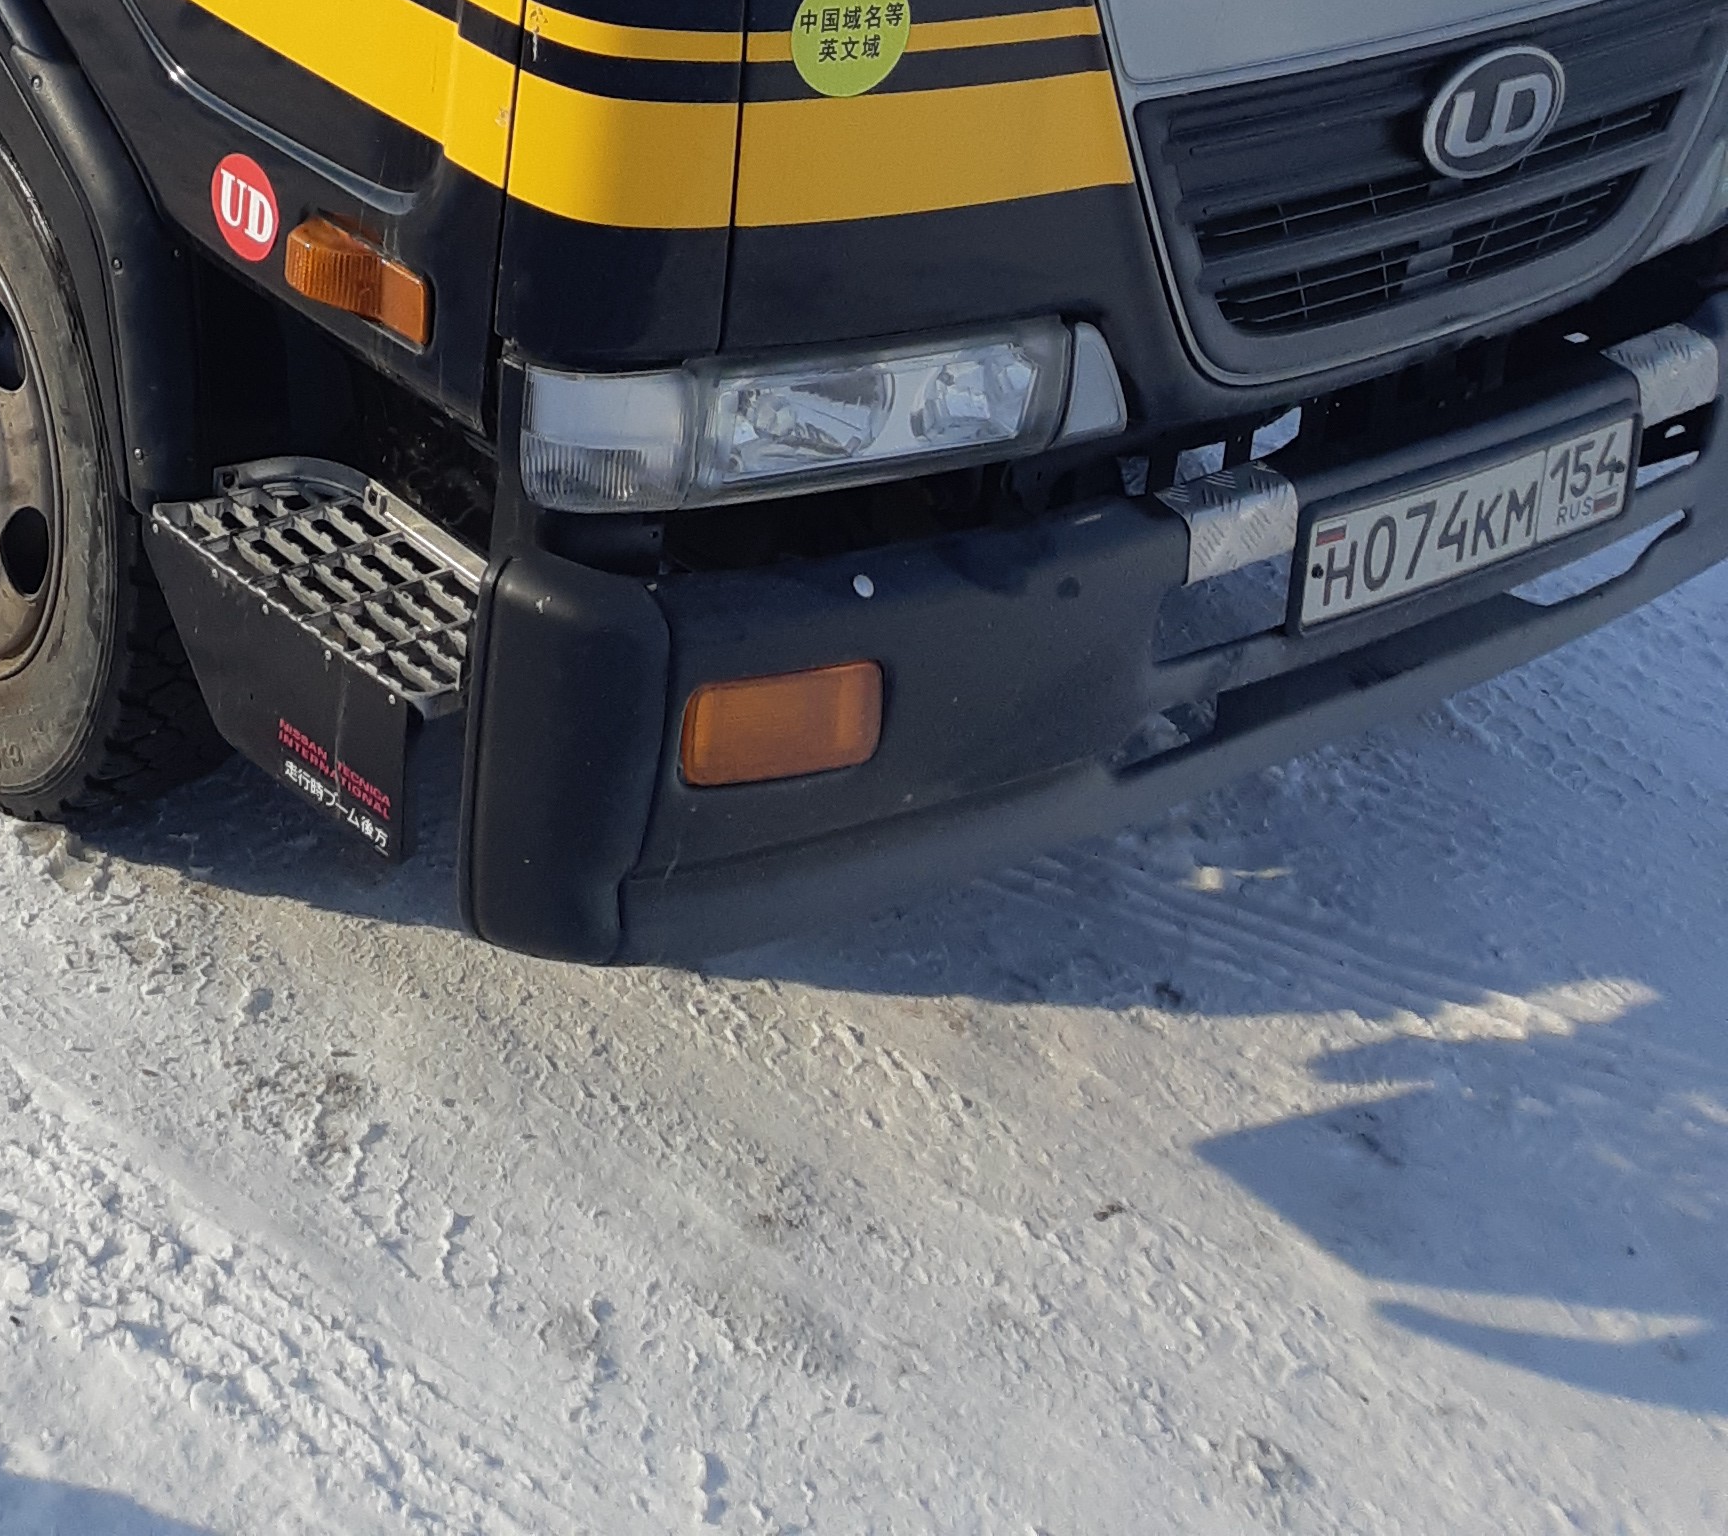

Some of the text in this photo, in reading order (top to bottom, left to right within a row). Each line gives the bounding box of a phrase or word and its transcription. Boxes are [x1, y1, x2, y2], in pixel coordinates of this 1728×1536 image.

[1444, 73, 1552, 158] UD
[220, 167, 274, 244] UD
[1548, 432, 1625, 505] 154
[1557, 495, 1594, 527] RUS
[278, 717, 391, 808] NISSAN TECNICA
[278, 729, 391, 821] INTERNATIONAL
